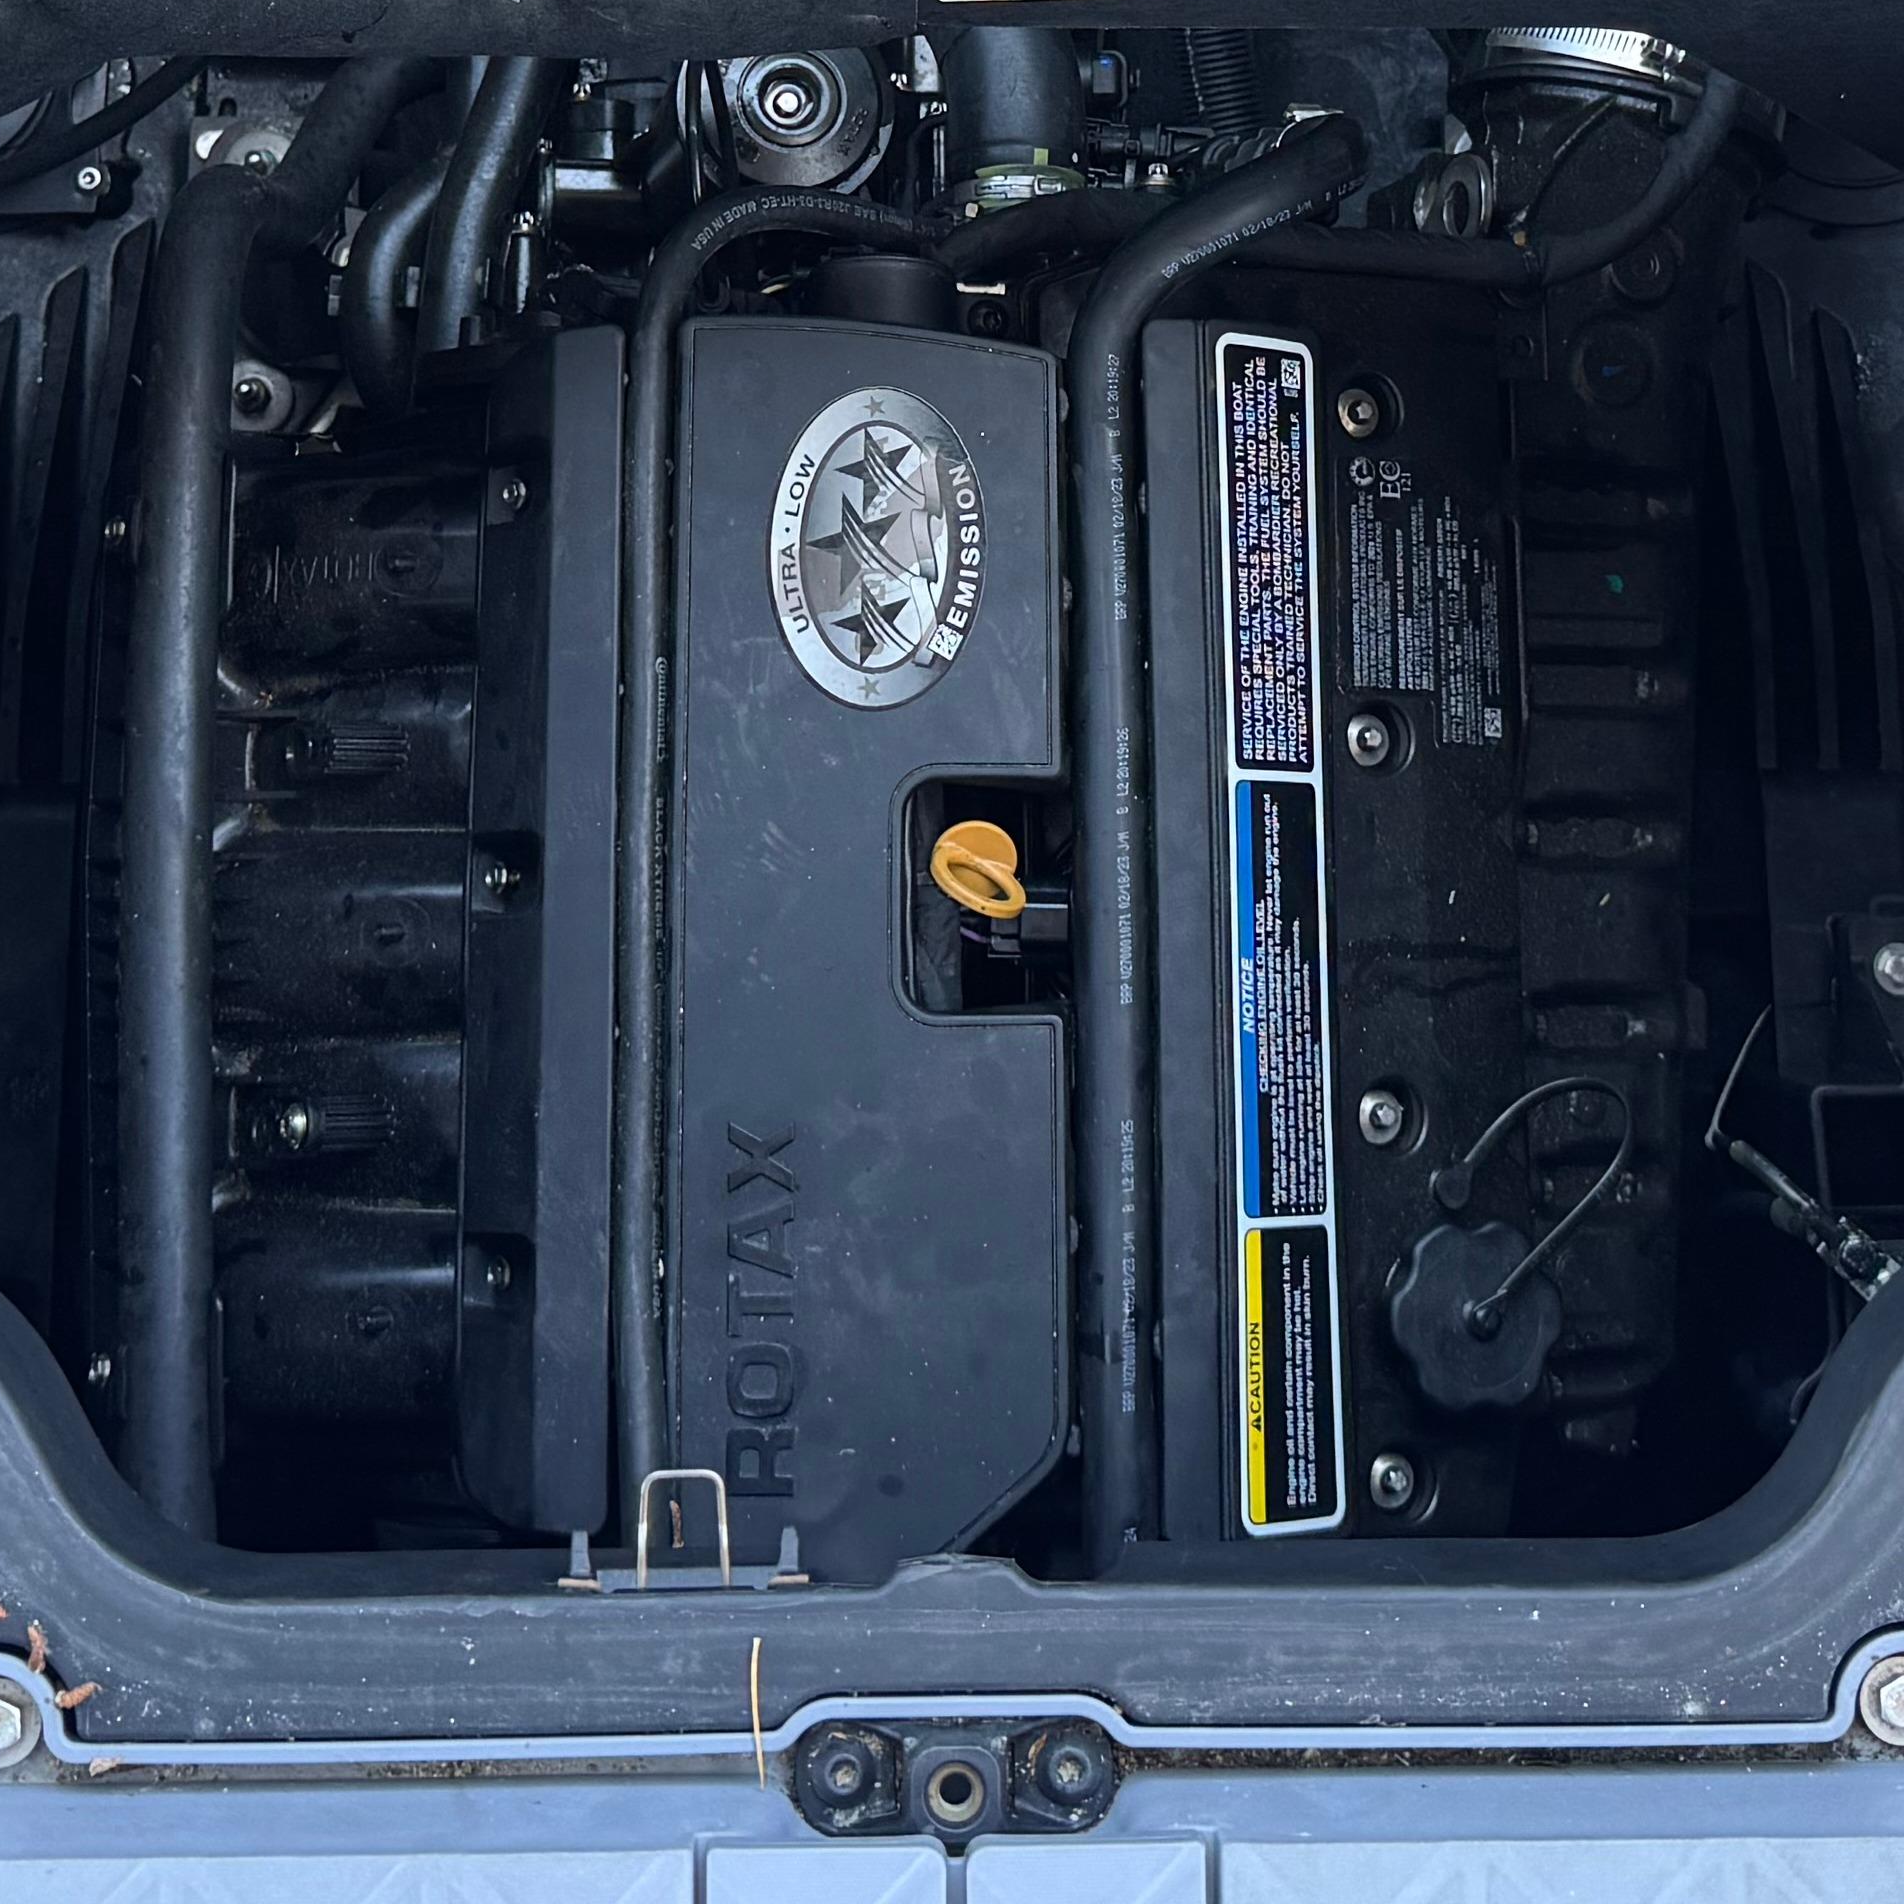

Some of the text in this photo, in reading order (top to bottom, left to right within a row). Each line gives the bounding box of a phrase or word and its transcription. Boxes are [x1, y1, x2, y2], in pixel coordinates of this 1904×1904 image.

[712, 216, 725, 232] IN
[723, 199, 757, 225] MADE
[691, 227, 715, 251] USA
[1107, 405, 1120, 419] L2
[1244, 359, 1255, 435] IDENTICAL
[1246, 439, 1256, 471] AND
[1268, 377, 1279, 490] RECREATIONAL
[1280, 441, 1290, 473] NOT
[1281, 476, 1290, 499] DO
[1400, 472, 1411, 491] 121
[1247, 474, 1258, 545] TRAINING
[782, 454, 816, 633] ULTRA LOW
[947, 463, 981, 628] EMISSION
[1256, 356, 1275, 760] REPLACEMENT PARTS. THE FUEL SYSTEM SHOULD BE
[1271, 494, 1282, 595] BOMBARDIER
[1233, 381, 1252, 759] SERVICE OF THE ENGINE INSTALLED IN THIS BOAT
[1290, 411, 1307, 762] ATTEMPT TO SERVICE THE SYSTEM YOURSELF.
[1251, 608, 1262, 674] SPECIAL
[1274, 613, 1283, 633] BY
[1284, 603, 1295, 670] TRAINED
[1274, 637, 1284, 677] ONLY
[1252, 678, 1264, 760] REQUIRES
[1276, 681, 1286, 761] SERVICED
[1286, 674, 1297, 762] PRODUCTS
[1116, 782, 1129, 795] L2
[1116, 855, 1131, 909] 02/18/23
[1241, 957, 1255, 1033] NOTICE
[1257, 967, 1266, 1018] ENGINE
[1258, 1021, 1268, 1092] CHECKING
[726, 1121, 795, 1496] ROTAX
[1293, 1314, 1301, 1331] be
[1303, 1292, 1312, 1319] skin
[1304, 1322, 1312, 1334] in
[1249, 1321, 1261, 1413] CAUTION
[1281, 1242, 1298, 1505] Engine oil and certain component in the
[1294, 1336, 1304, 1363] may
[1304, 1339, 1313, 1375] result
[1294, 1367, 1307, 1454] compartment
[1306, 1378, 1315, 1407] may
[1306, 1411, 1316, 1459] contact
[1297, 1458, 1308, 1504] engine
[1307, 1463, 1317, 1502] Direct
